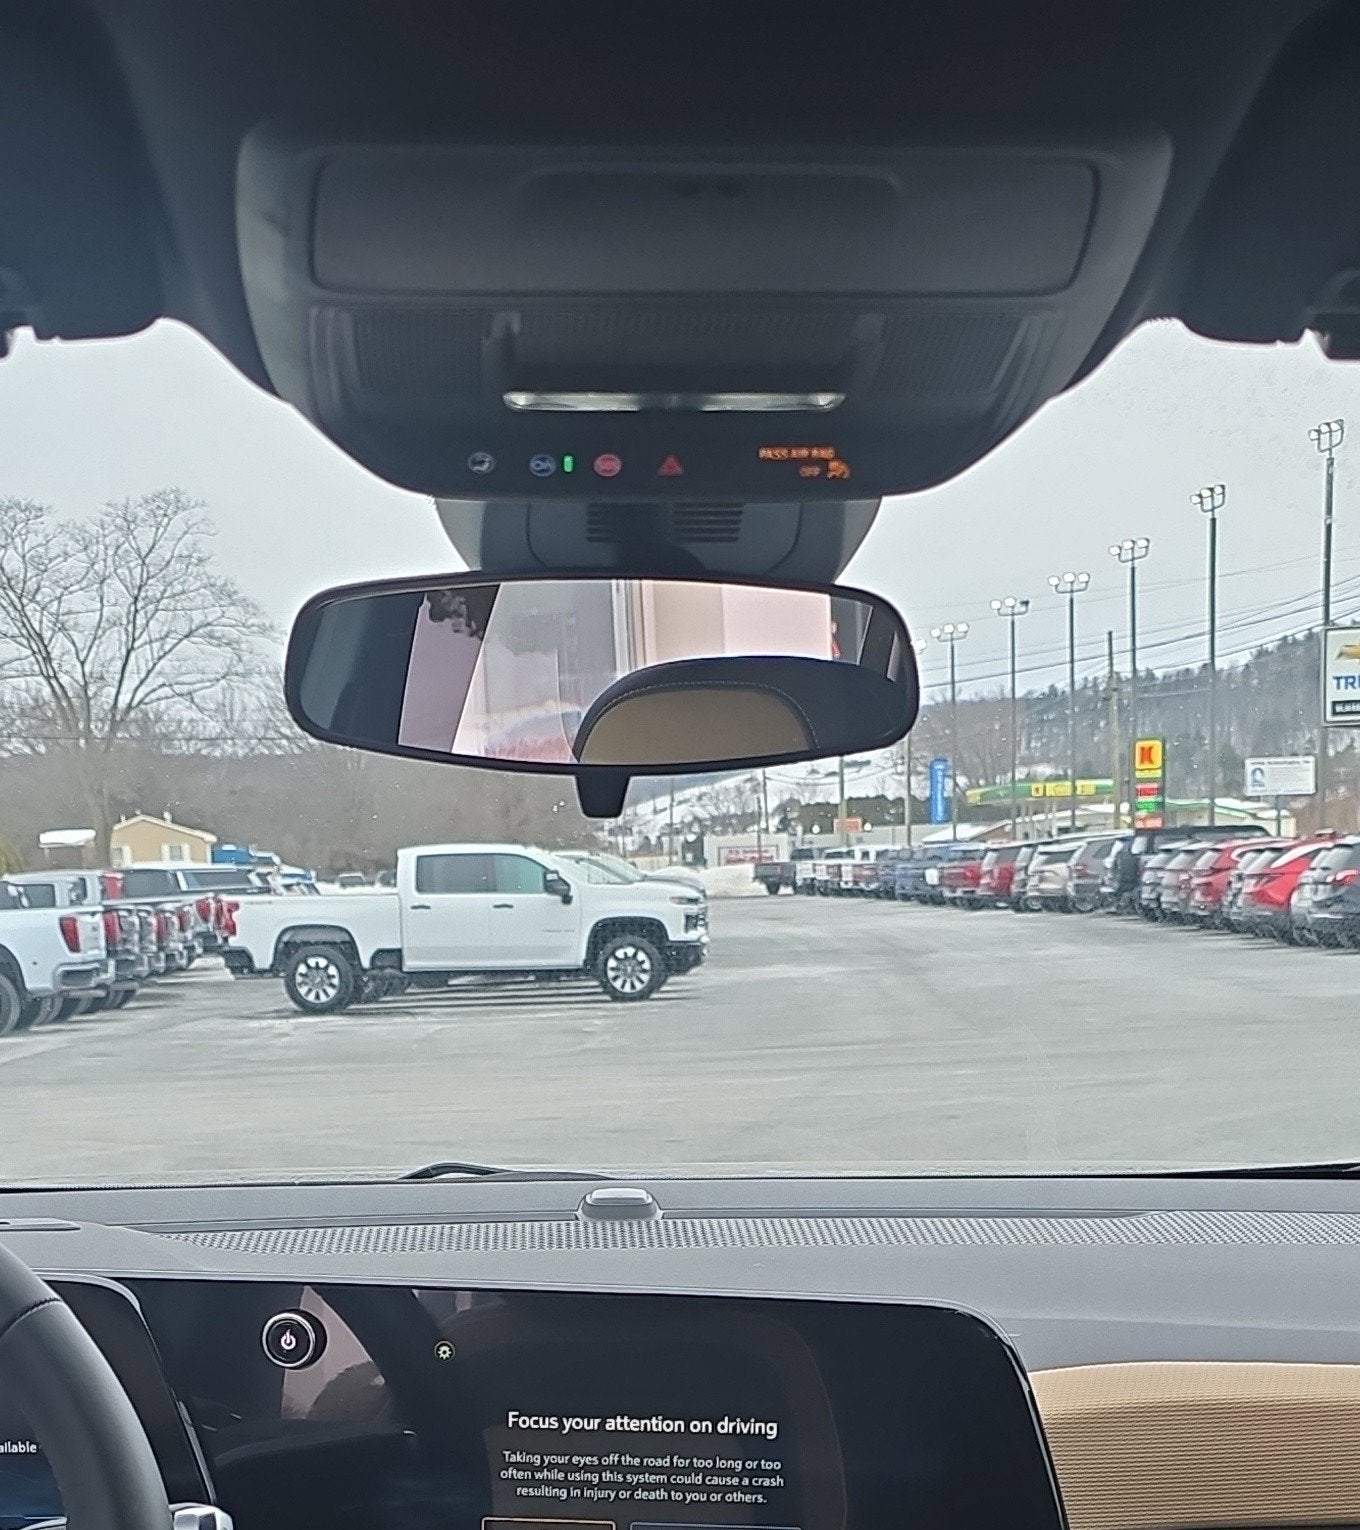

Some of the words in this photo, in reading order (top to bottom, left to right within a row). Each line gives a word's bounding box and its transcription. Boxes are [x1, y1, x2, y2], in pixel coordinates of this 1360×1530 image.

[508, 1411, 559, 1430] Focus
[562, 1417, 602, 1434] your
[605, 1415, 685, 1433] attention
[690, 1420, 713, 1434] on
[716, 1417, 778, 1440] driving
[503, 1451, 541, 1466] Taking
[543, 1455, 569, 1467] your
[571, 1455, 599, 1467] eyes
[601, 1454, 620, 1466] off
[621, 1454, 641, 1467] the
[643, 1454, 671, 1467] road
[673, 1455, 691, 1468] for
[693, 1457, 713, 1469] too
[715, 1457, 743, 1472] long
[745, 1461, 760, 1470] or
[761, 1458, 782, 1470] too
[500, 1469, 532, 1481] often
[534, 1469, 565, 1481] while
[567, 1470, 600, 1484] using
[601, 1471, 624, 1482] this
[625, 1473, 668, 1486] system
[670, 1473, 703, 1485] could
[705, 1475, 740, 1486] cause
[741, 1477, 749, 1486] a
[751, 1475, 784, 1487] crash
[516, 1485, 568, 1500] resulting
[570, 1486, 581, 1498] in
[584, 1487, 617, 1502] injury
[619, 1490, 633, 1500] or
[634, 1488, 668, 1500] death
[671, 1490, 683, 1501] to
[685, 1491, 708, 1504] you
[709, 1492, 723, 1502] or
[725, 1491, 768, 1504] others.
